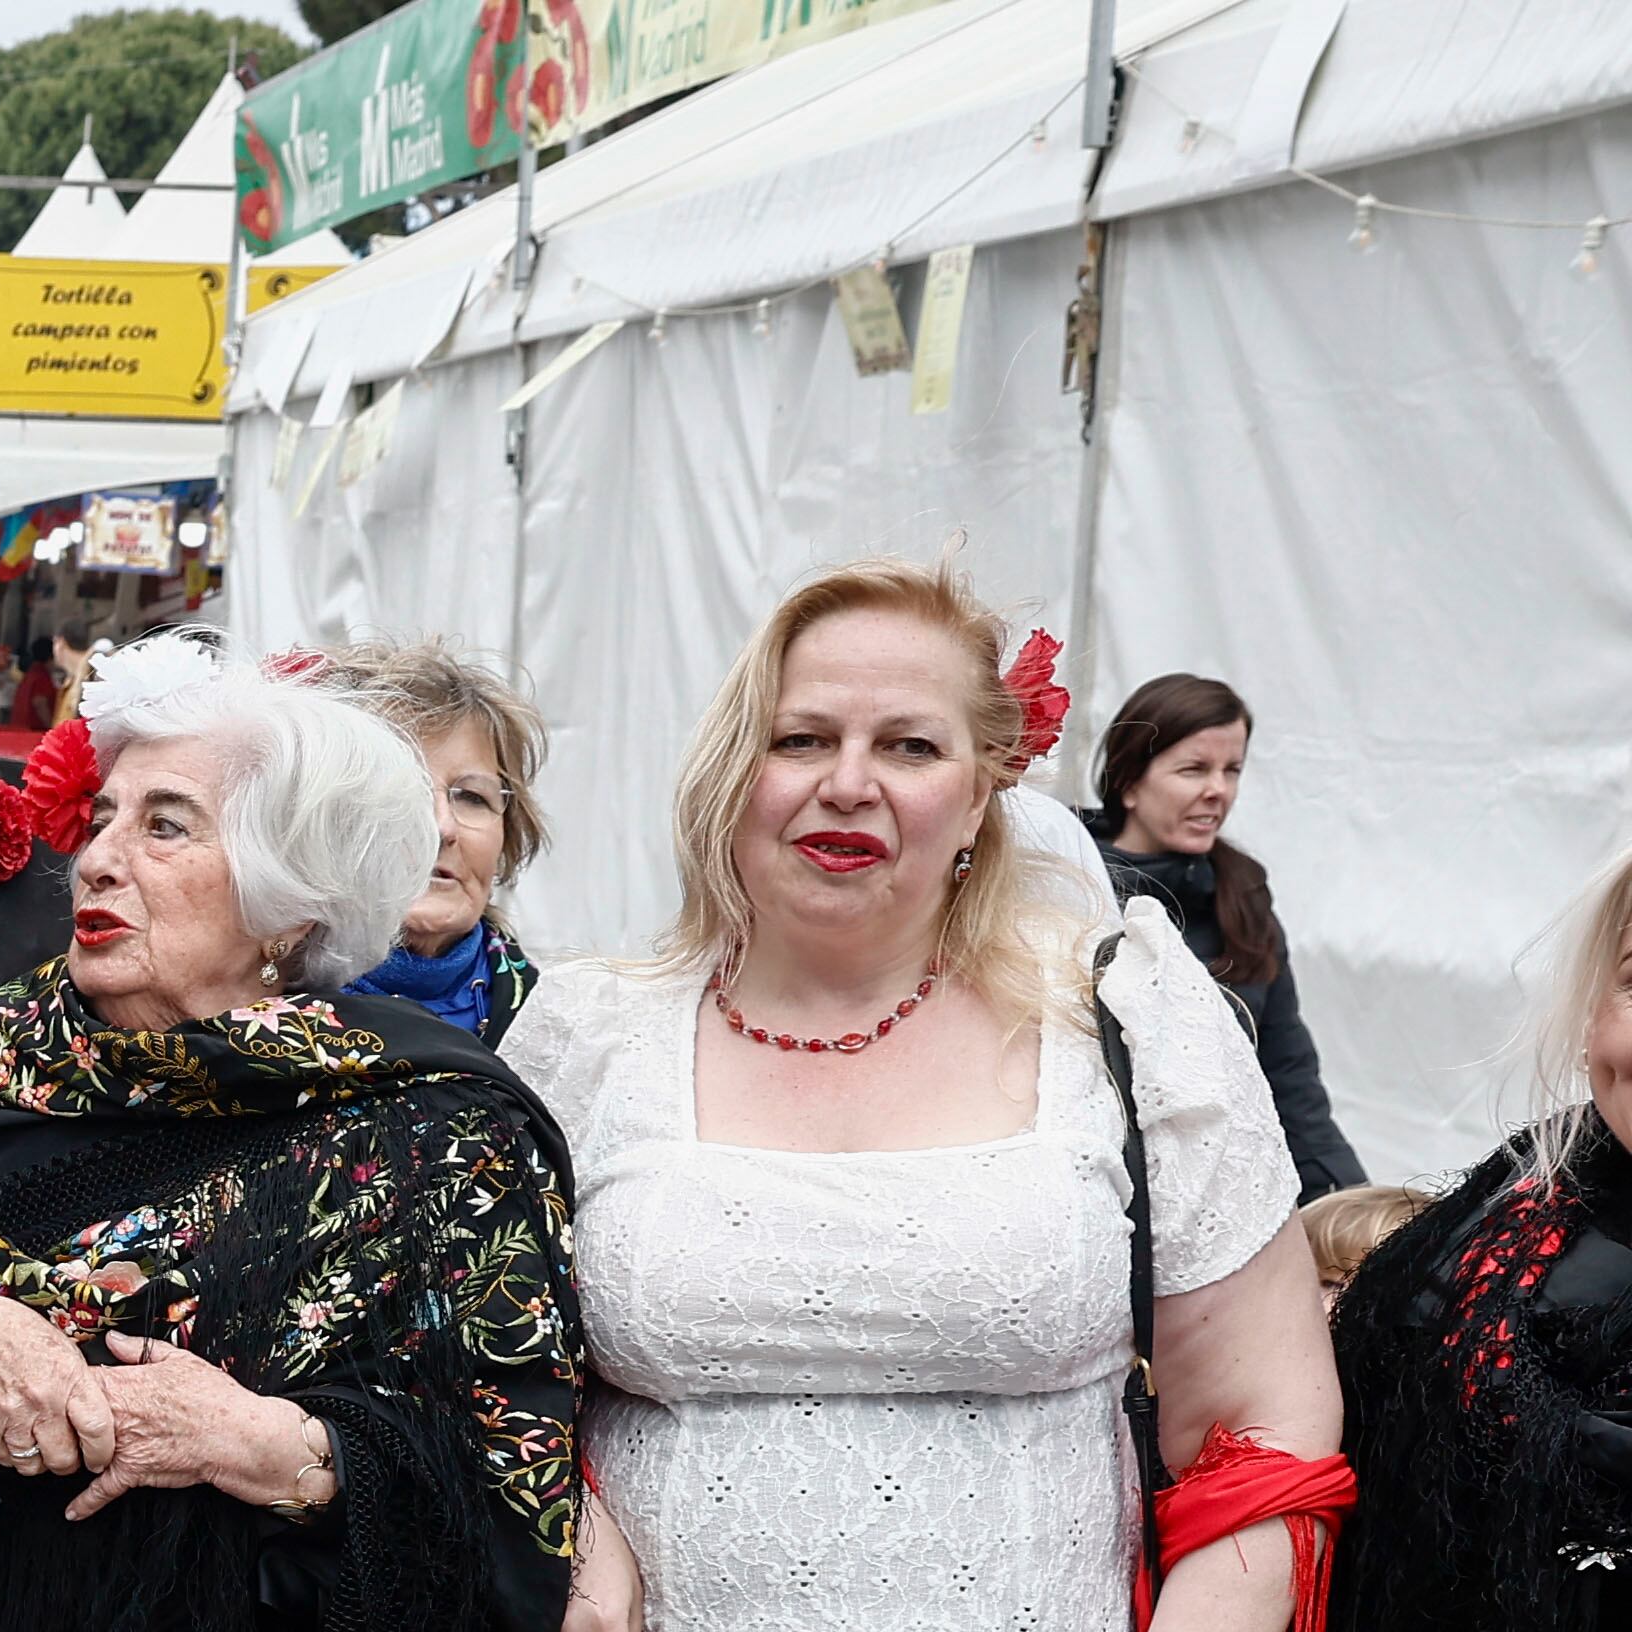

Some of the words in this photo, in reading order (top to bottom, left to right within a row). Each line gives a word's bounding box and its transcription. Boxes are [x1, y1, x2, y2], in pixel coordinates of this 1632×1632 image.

[391, 70, 425, 131] Más
[392, 115, 445, 186] Madrid
[41, 284, 133, 306] Tortilla
[12, 322, 111, 342] campera
[118, 324, 158, 341] con
[26, 352, 140, 375] pimientos
